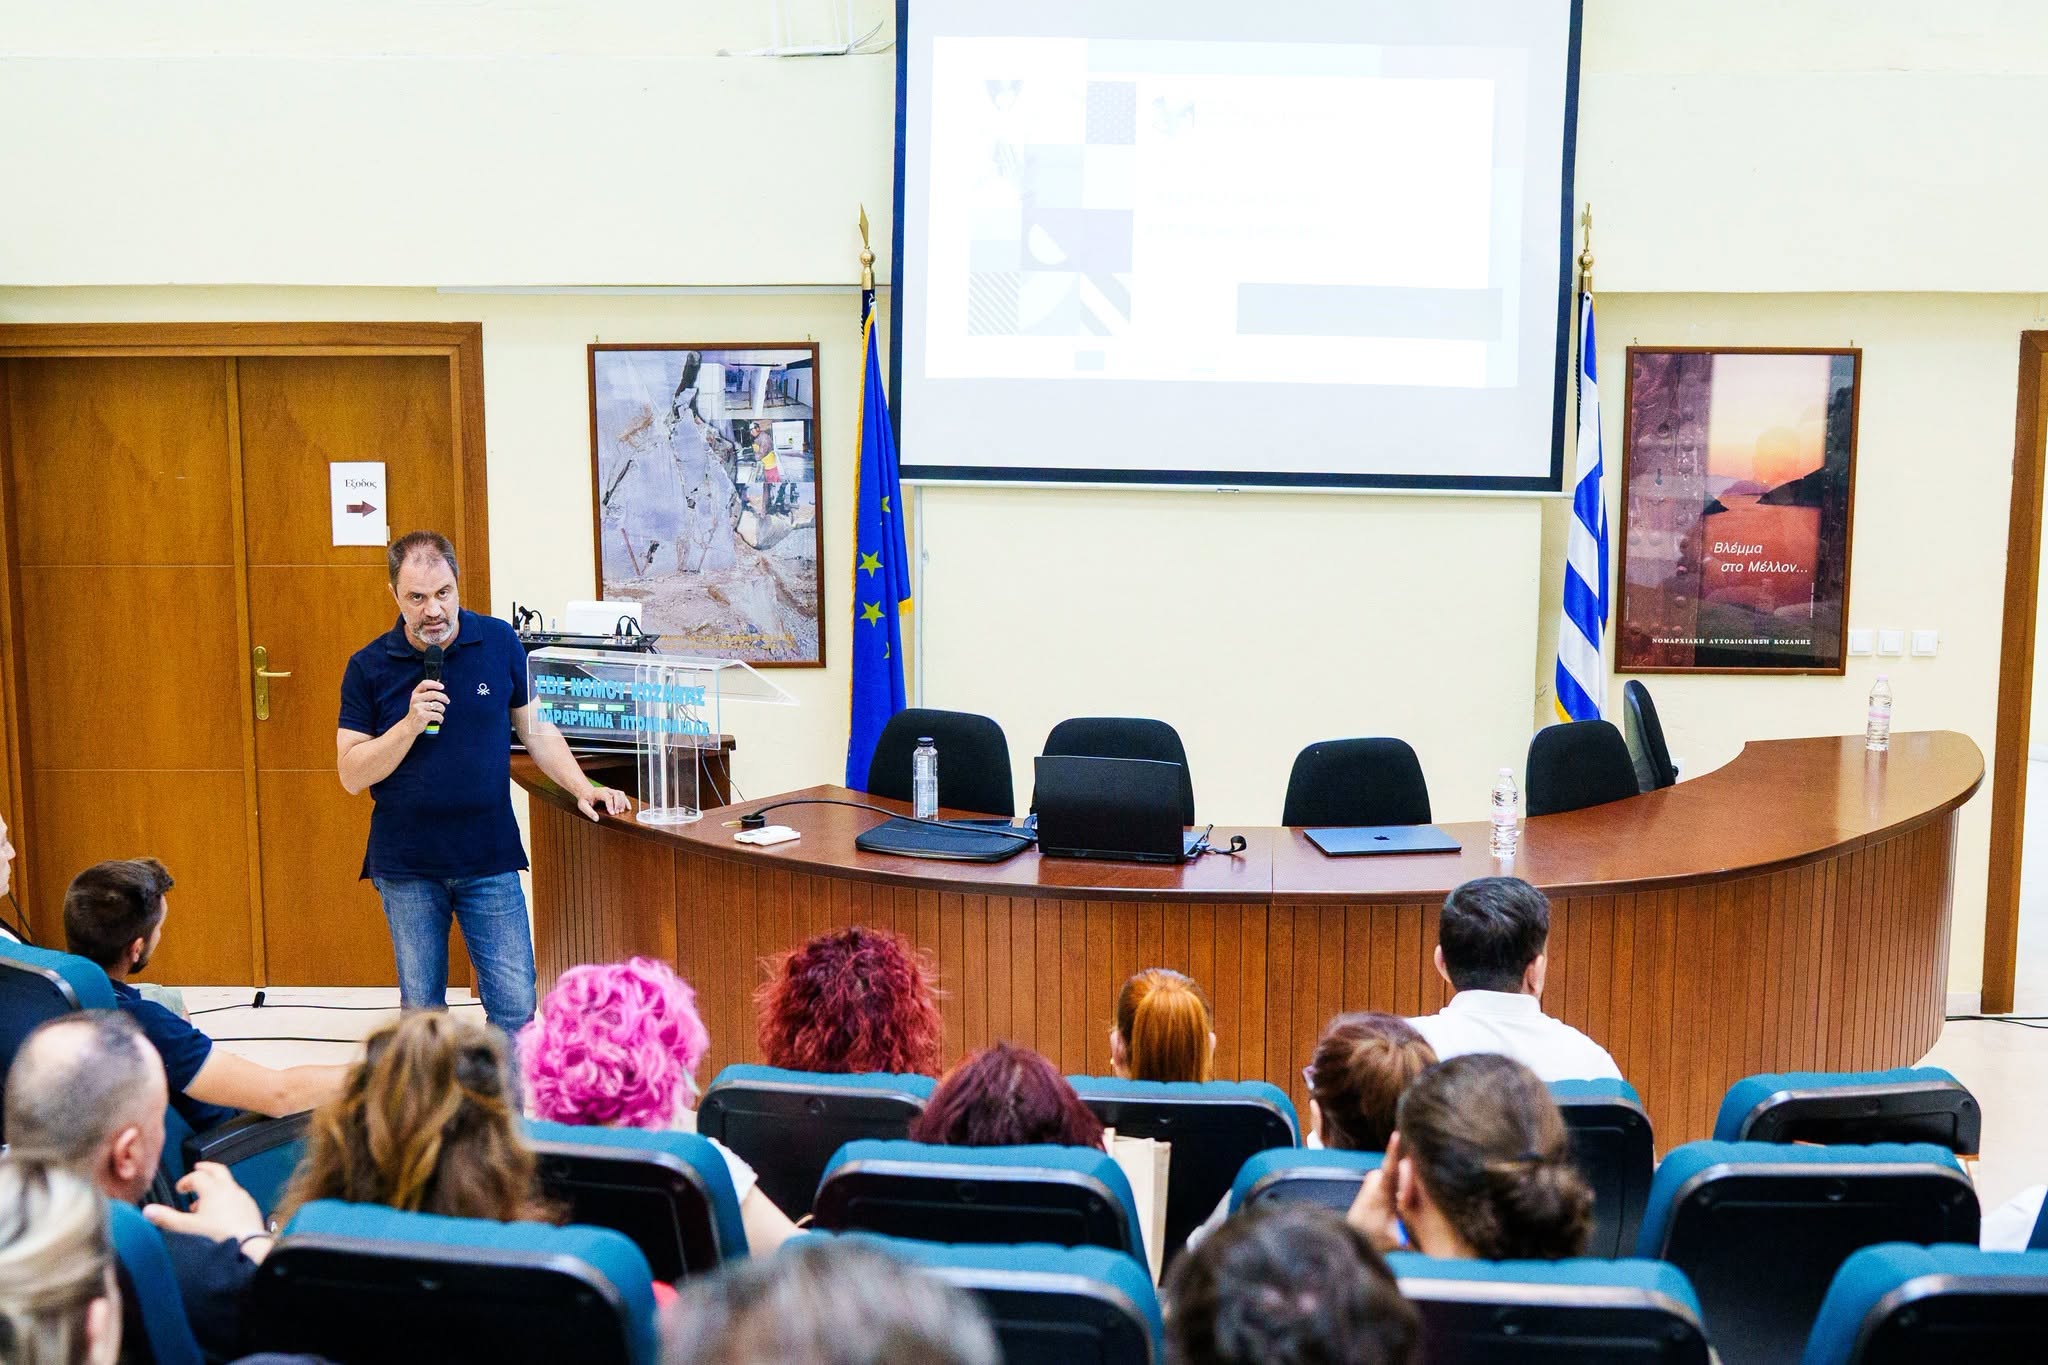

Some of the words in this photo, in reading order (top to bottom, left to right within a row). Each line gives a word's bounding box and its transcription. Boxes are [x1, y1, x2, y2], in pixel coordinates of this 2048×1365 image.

[1713, 541, 1763, 556] Βλέμμα
[1720, 562, 1744, 573] στο
[1748, 560, 1808, 573] Μέλλον...
[1651, 637, 1705, 645] ΝΟΜΑΡΧΙΑΚΗ
[1708, 637, 1770, 646] ΑΥΤΟΔΙΟΙΚΗΣΗ
[1773, 638, 1812, 646] ΚΟΖΑΝΗΣ
[536, 674, 566, 696] ΕΒΕ
[570, 677, 625, 701] ΝΟΜΟΥ
[537, 707, 614, 729] ΠΑΡΑΡΤΗΜΑ
